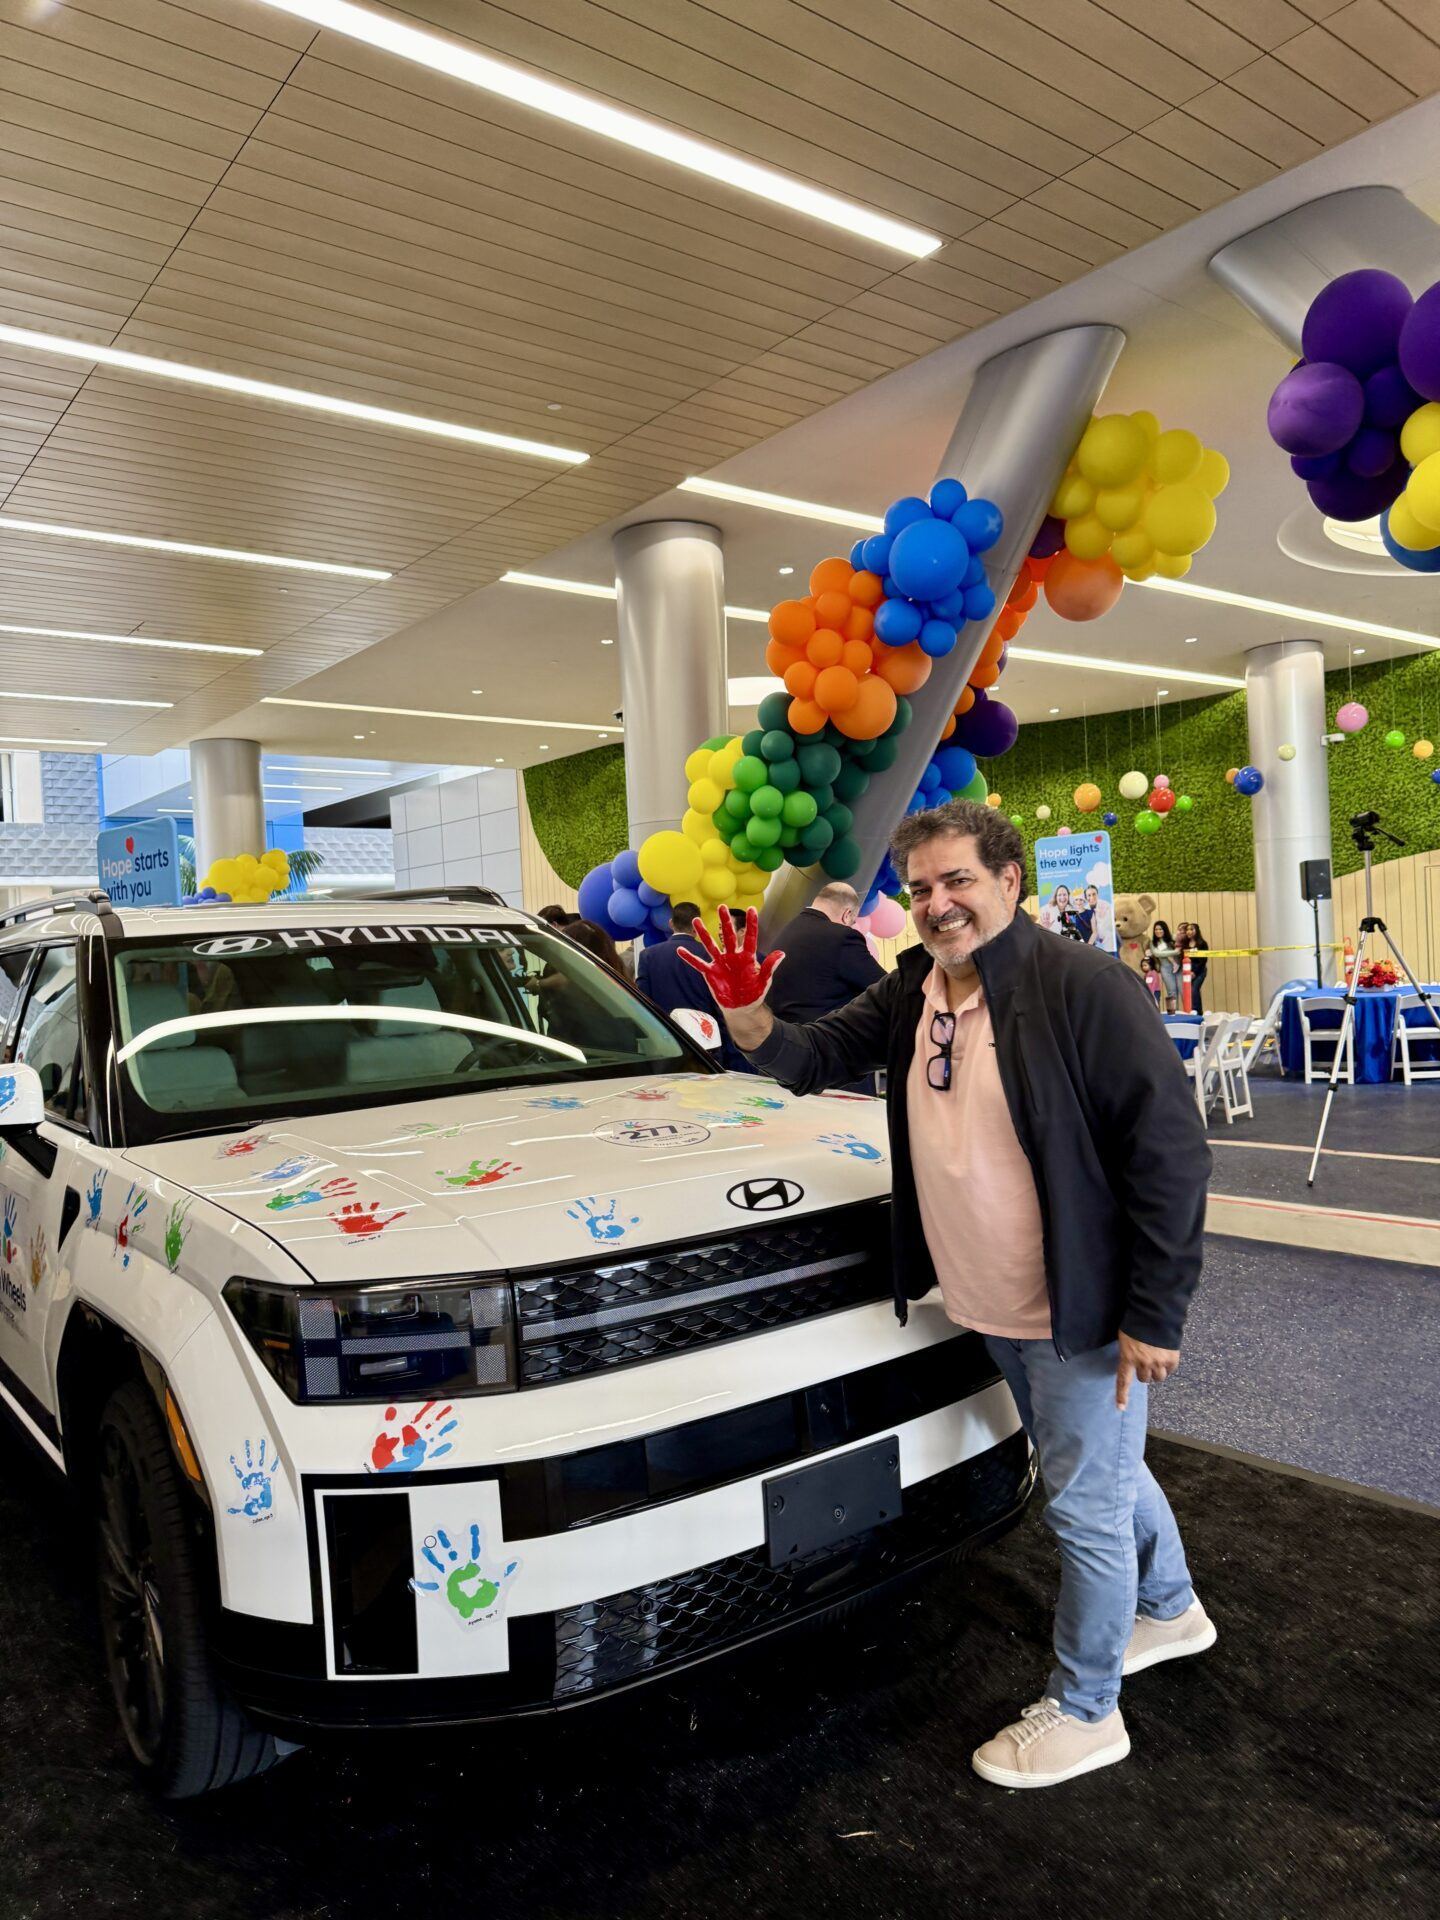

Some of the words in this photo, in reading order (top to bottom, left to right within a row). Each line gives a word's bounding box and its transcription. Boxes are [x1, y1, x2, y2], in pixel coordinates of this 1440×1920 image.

[1039, 848, 1068, 858] Hope
[1070, 844, 1100, 856] lights
[102, 858, 132, 880] Hope
[134, 848, 169, 872] starts
[1040, 859, 1057, 869] the
[1060, 857, 1082, 867] way
[104, 880, 128, 901] with
[130, 880, 152, 903] you
[278, 926, 522, 949] HYUNDAI
[619, 1125, 679, 1140] 277
